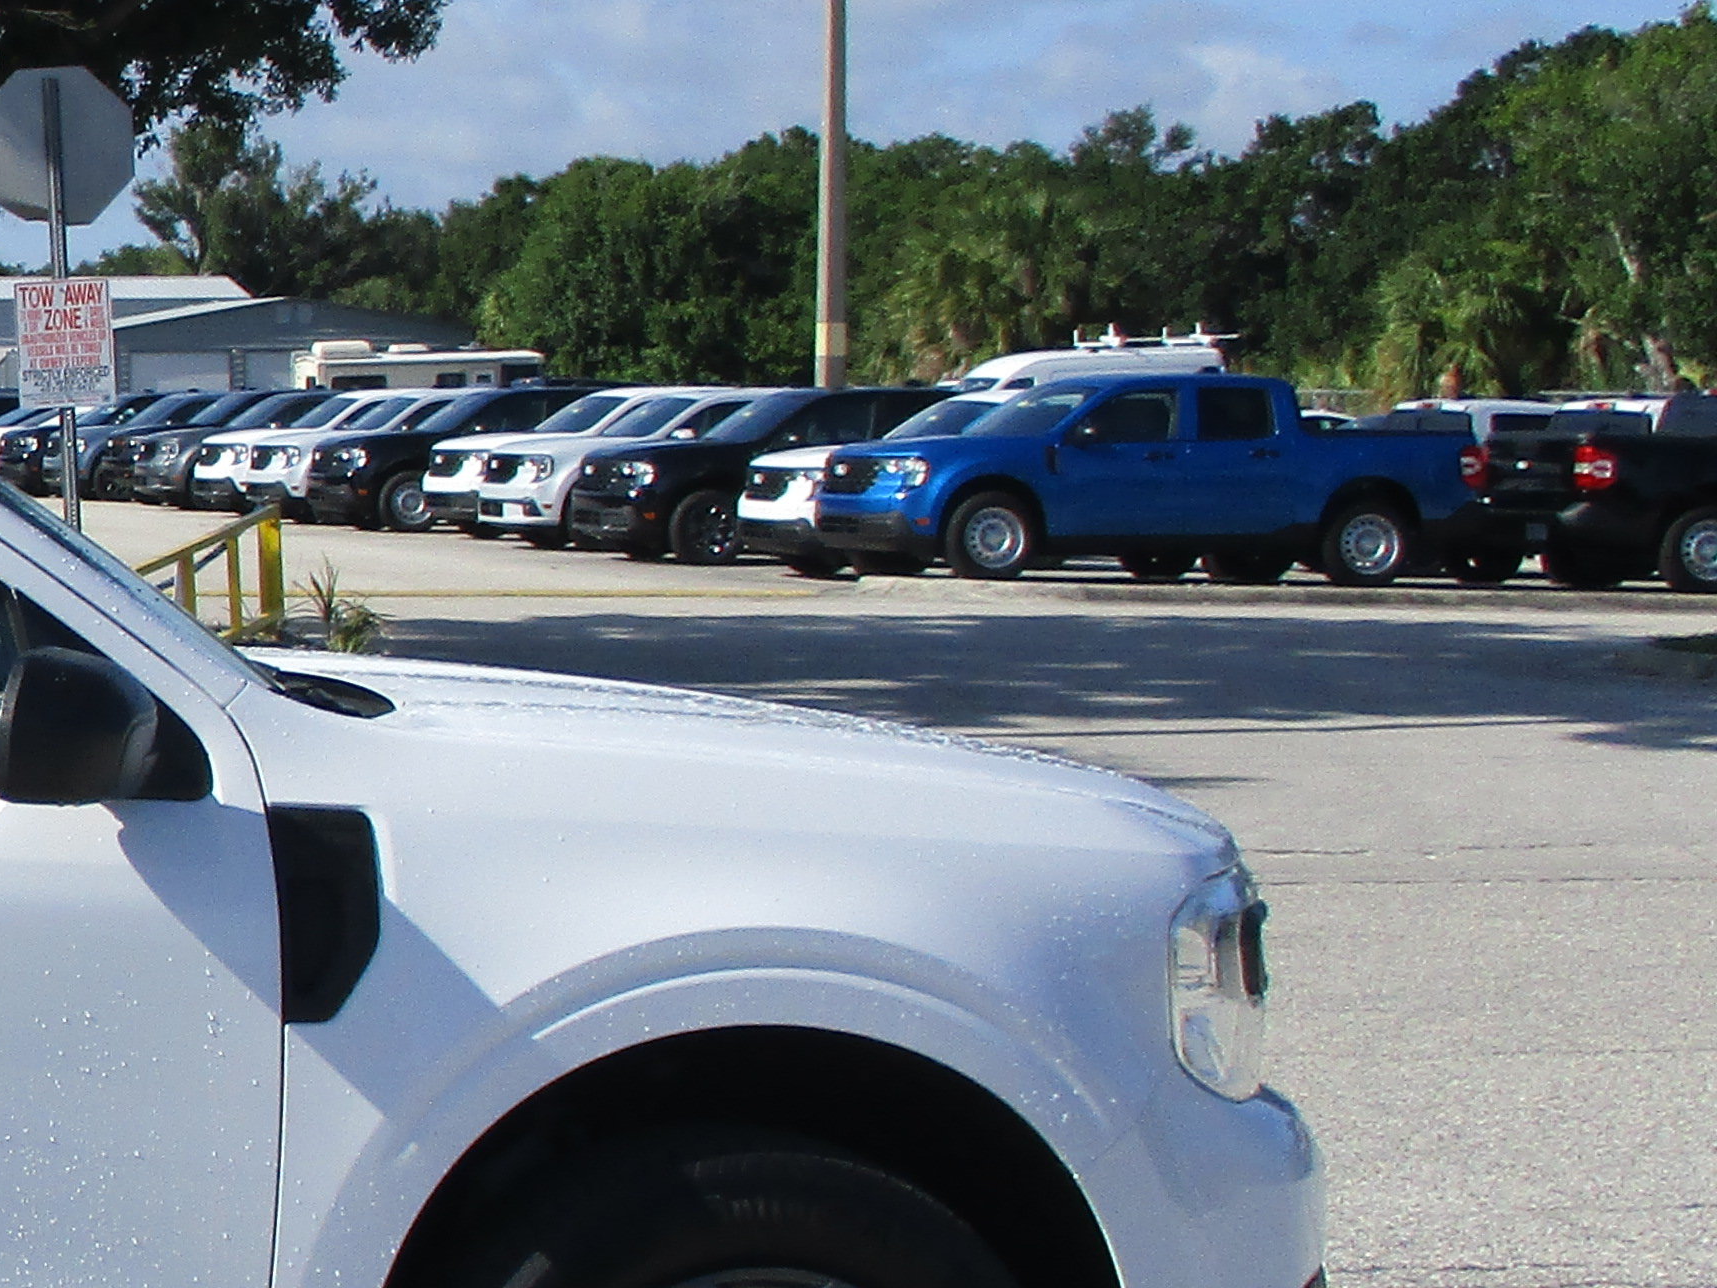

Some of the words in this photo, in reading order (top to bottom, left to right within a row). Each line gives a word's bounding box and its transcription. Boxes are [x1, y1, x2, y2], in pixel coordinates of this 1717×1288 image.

[19, 285, 53, 308] TOW
[64, 282, 103, 306] AWAY
[43, 307, 82, 331] ZONE
[22, 368, 64, 384] STRICTLY
[64, 365, 111, 381] ENFORCED
